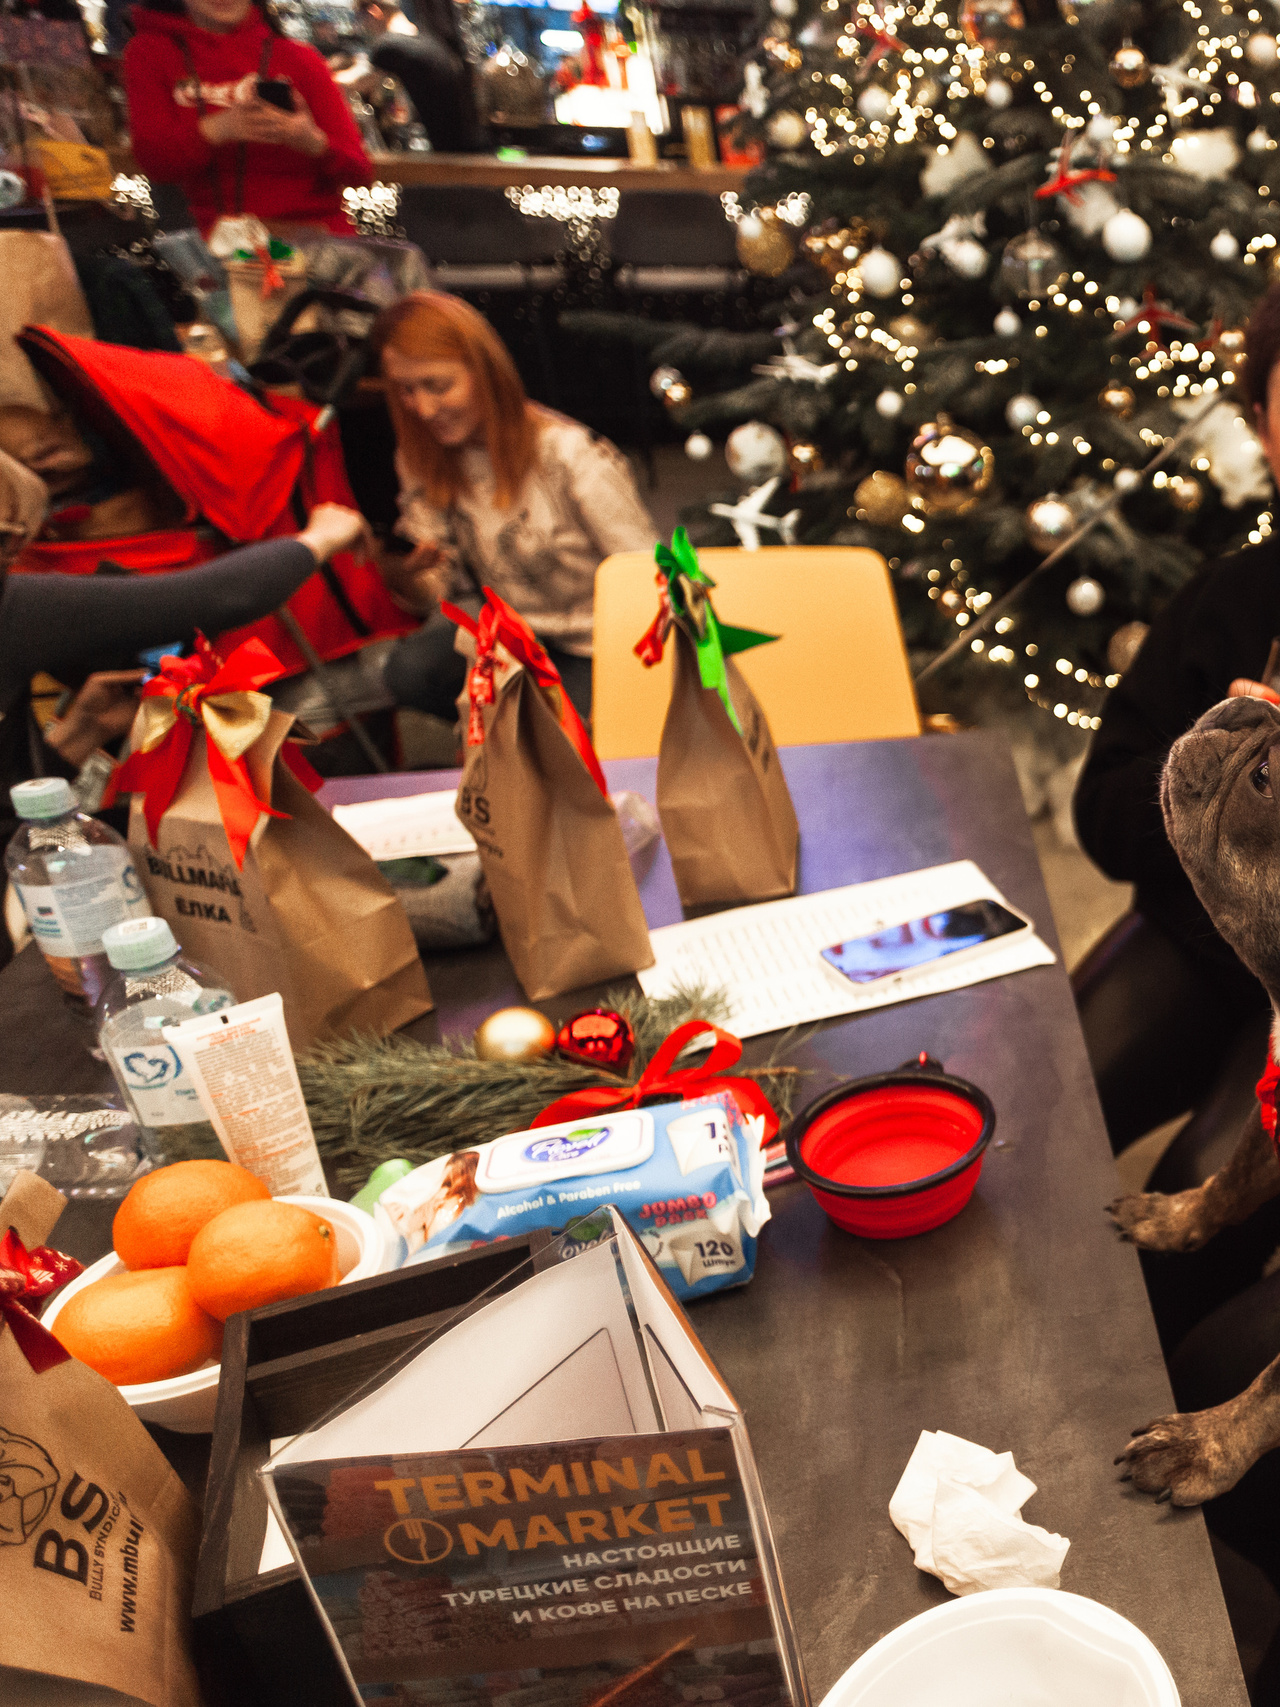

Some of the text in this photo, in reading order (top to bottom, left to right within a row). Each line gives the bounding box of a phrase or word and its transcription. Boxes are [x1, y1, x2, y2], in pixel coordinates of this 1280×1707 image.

[174, 895, 231, 923] ЕЛКА
[497, 1196, 543, 1219] Alcohol
[558, 1184, 611, 1203] Paraben
[612, 1179, 642, 1194] Free
[639, 1191, 718, 1220] JUMBO
[695, 1239, 735, 1258] 120
[374, 1449, 726, 1515] TERMINAL
[33, 1470, 110, 1586] BS
[457, 1493, 732, 1556] MARKET
[562, 1534, 742, 1569] НАСТОЯЩИЕ
[89, 1558, 105, 1602] BULLY
[441, 1558, 747, 1608] ТУРЕЦКИЕ СЛАДОСТИ
[512, 1581, 753, 1625] И КОФЕ НА ПЕСКЕ
